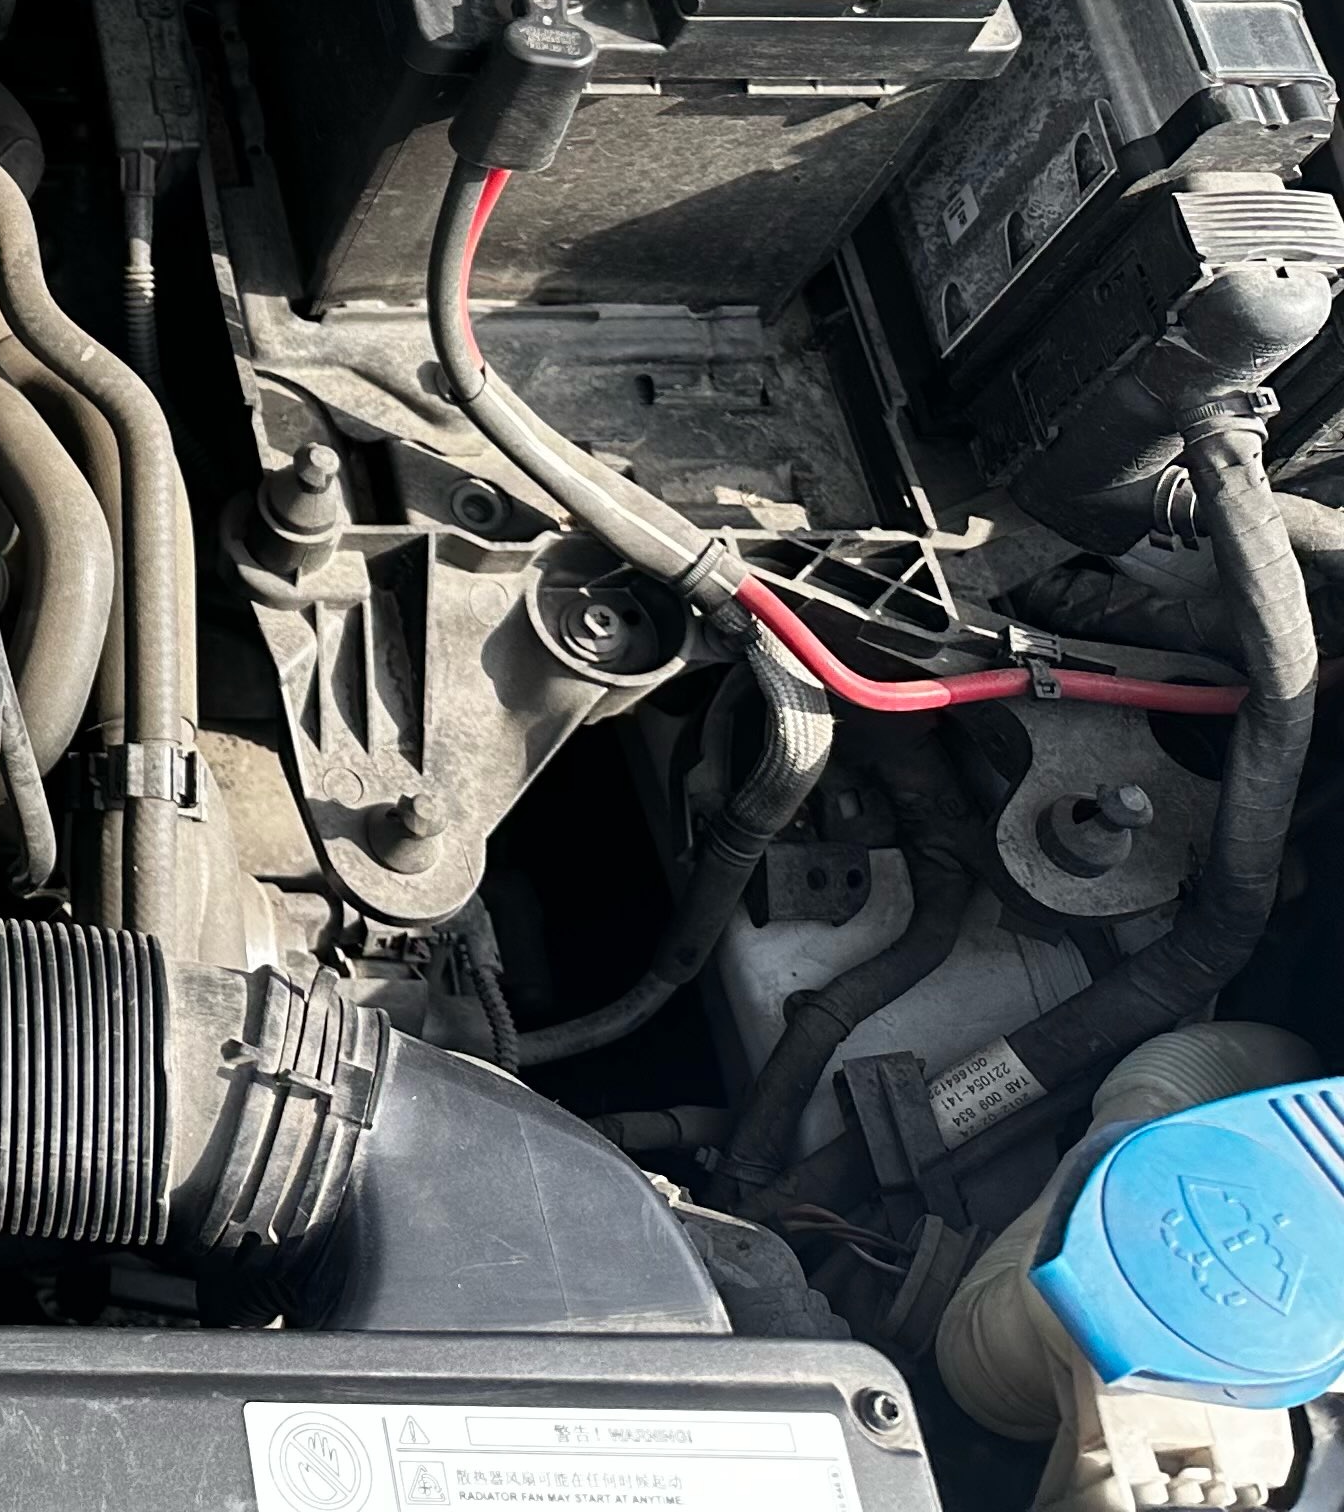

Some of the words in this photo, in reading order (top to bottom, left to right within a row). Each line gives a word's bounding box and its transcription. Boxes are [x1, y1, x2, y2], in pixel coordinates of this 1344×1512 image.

[941, 1062, 1011, 1110] 221054-141
[1004, 1075, 1031, 1094] TAB
[952, 1107, 977, 1127] 834
[459, 1491, 517, 1502] RADIATOR
[521, 1492, 543, 1502] FAN
[548, 1493, 570, 1503] MAY
[575, 1493, 611, 1504] START
[615, 1494, 628, 1504] AT
[632, 1494, 683, 1505] ANYTIME
